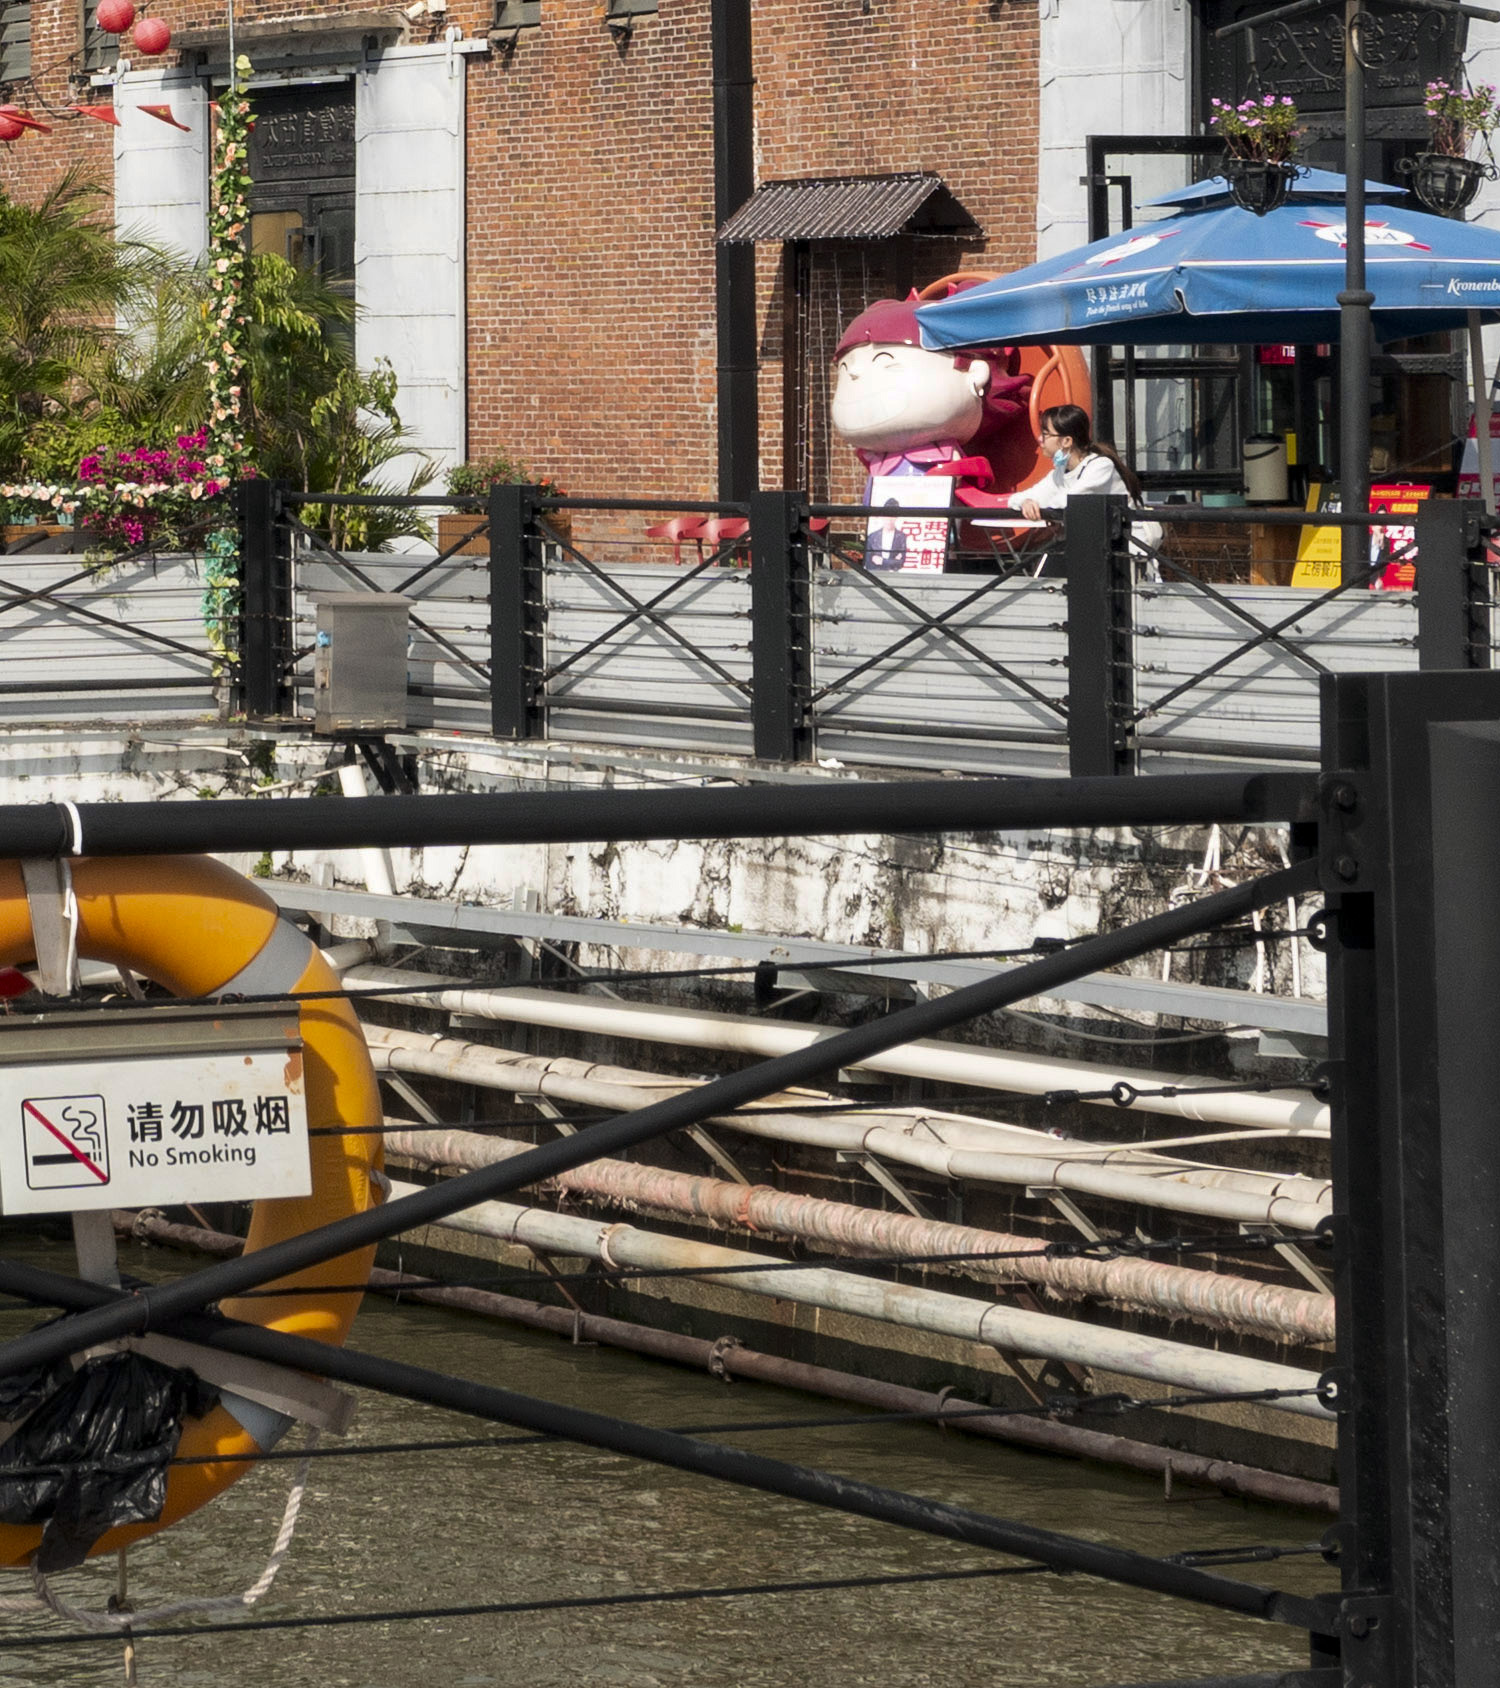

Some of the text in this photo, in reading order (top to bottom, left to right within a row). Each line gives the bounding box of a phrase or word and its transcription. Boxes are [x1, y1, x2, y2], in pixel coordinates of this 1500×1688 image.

[901, 521, 948, 541] 免费
[127, 1095, 291, 1143] 请勿吸烟
[129, 1143, 256, 1168] No Smoking
